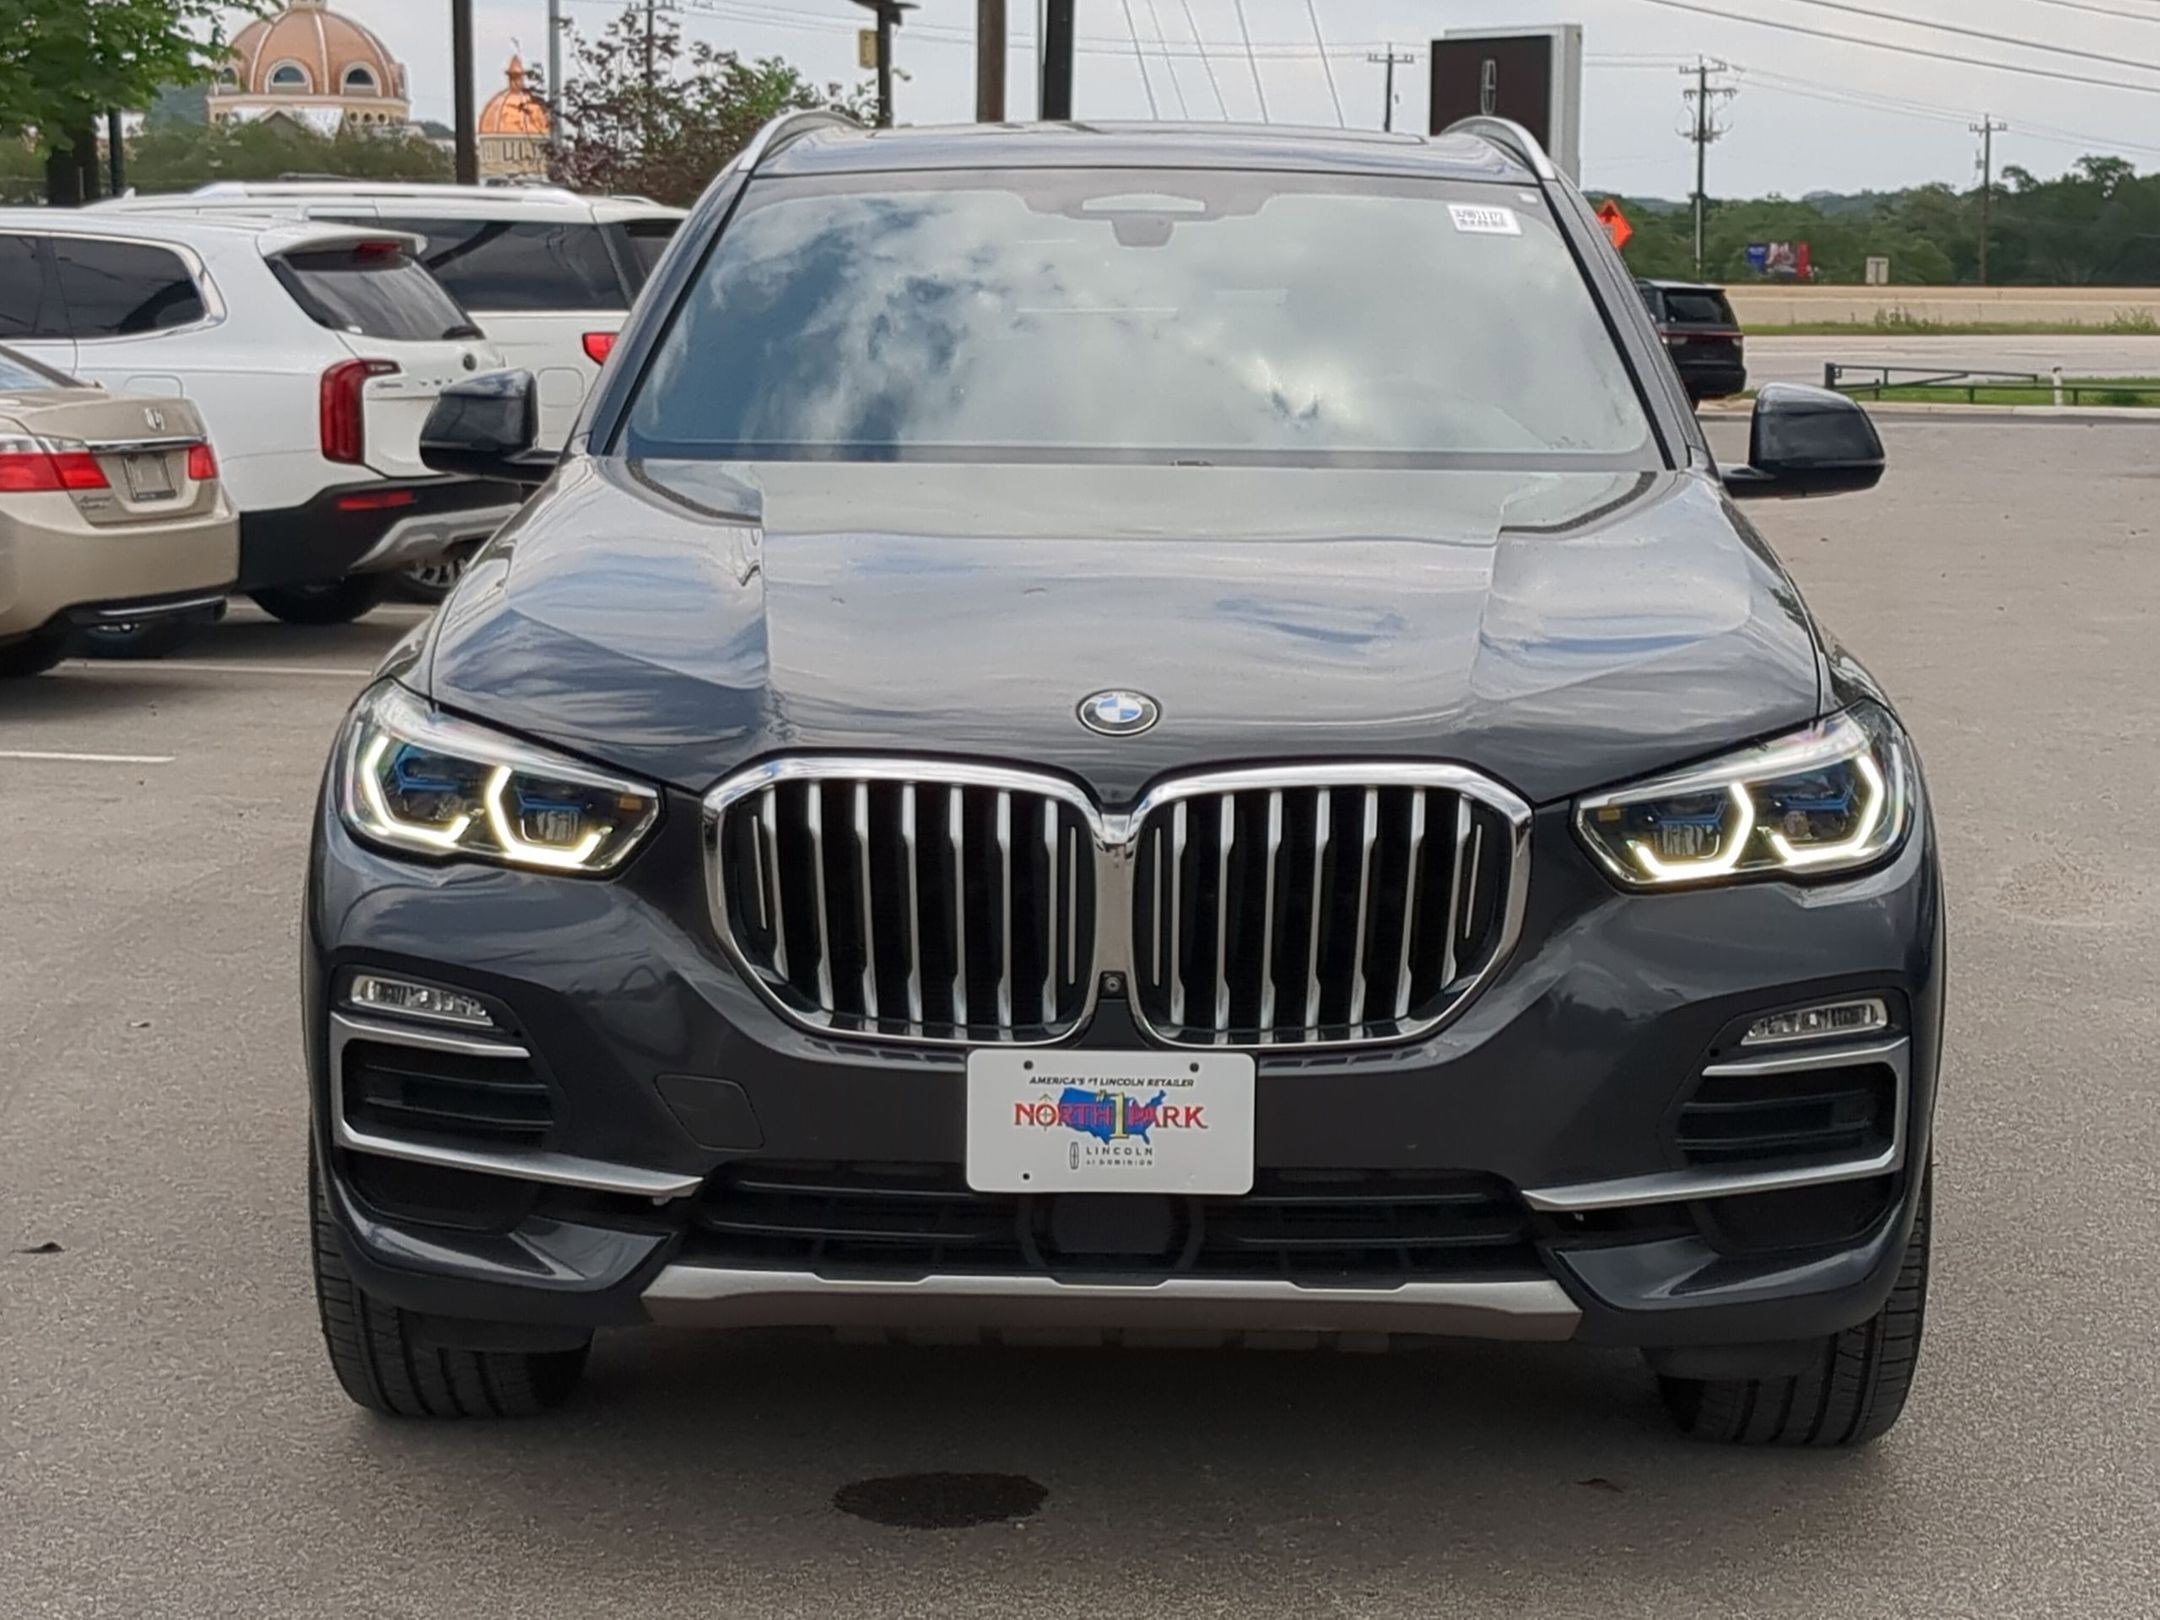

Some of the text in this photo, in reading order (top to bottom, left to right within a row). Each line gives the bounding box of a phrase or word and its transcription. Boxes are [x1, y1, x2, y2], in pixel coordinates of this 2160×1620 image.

[1029, 1076, 1085, 1086] AMERICA'S
[1099, 1076, 1145, 1087] LINCOLN
[1146, 1077, 1194, 1088] RETAILER
[1013, 1103, 1209, 1129] NORTH PARK
[1086, 1146, 1152, 1156] LINCOLN
